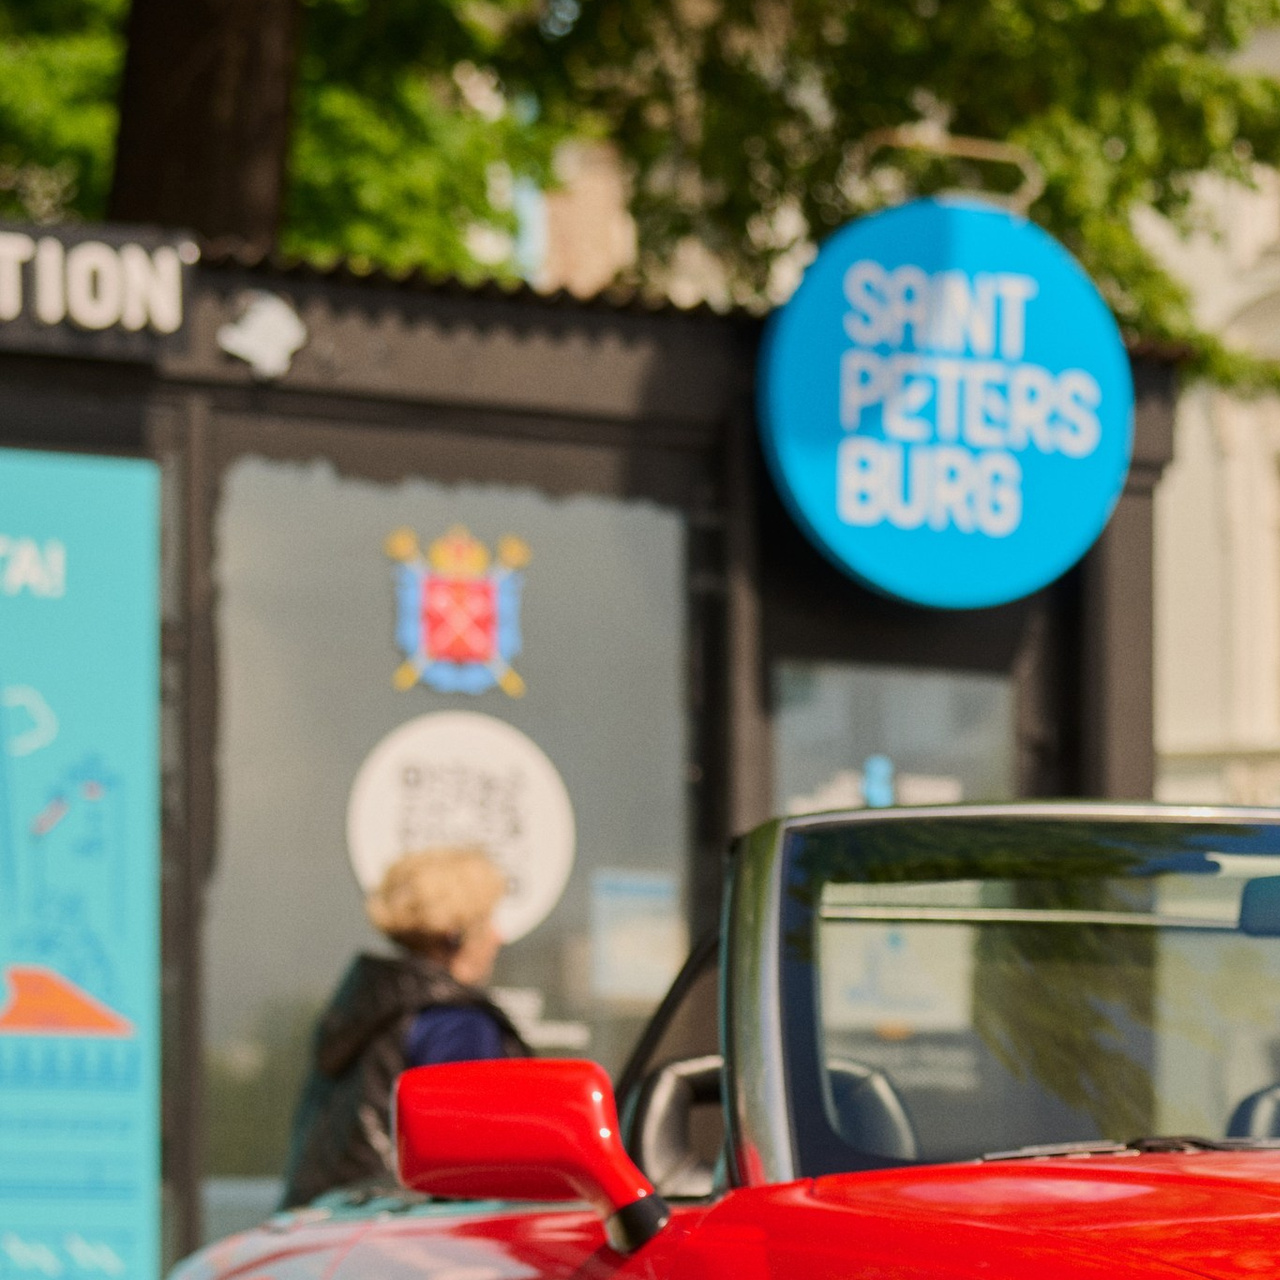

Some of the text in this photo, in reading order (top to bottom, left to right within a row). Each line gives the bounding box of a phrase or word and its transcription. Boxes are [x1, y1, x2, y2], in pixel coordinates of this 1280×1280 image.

[842, 259, 1038, 360] SAINT
[839, 347, 1102, 459] PETERS
[836, 435, 1023, 538] BURG
